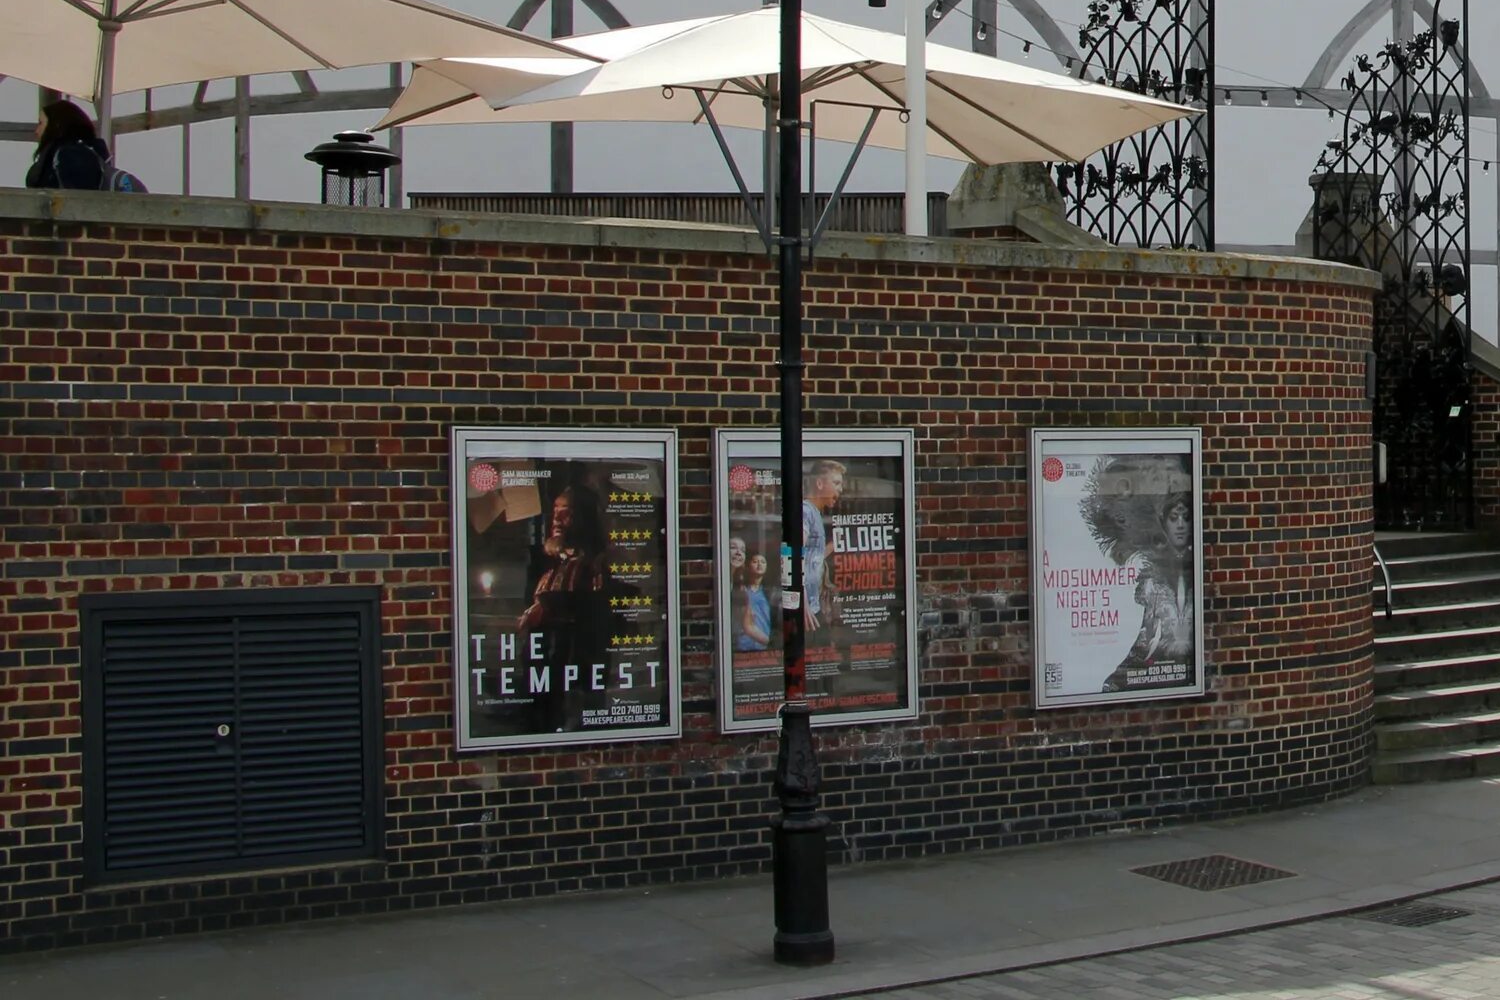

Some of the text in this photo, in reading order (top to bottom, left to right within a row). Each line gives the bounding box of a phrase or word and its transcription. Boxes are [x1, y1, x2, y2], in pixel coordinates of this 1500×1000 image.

[502, 478, 535, 486] PLAYHOUSE
[516, 470, 551, 478] WANAMAKER
[832, 513, 894, 527] SHAKESPEARE'S
[832, 525, 896, 553] GLOBE
[834, 552, 896, 572] SUMMER
[1043, 550, 1049, 567] A
[834, 570, 896, 592] SCHOOLS
[1043, 567, 1136, 588] MIDSUMMER
[866, 594, 881, 602] year
[1056, 588, 1110, 608] NIGHT'S
[1071, 609, 1119, 629] DREAM
[471, 632, 545, 662] THE
[472, 661, 661, 696] TEMPEST
[1148, 666, 1160, 675] 020
[1160, 665, 1172, 674] 7401
[1172, 664, 1186, 673] 9919
[582, 709, 595, 717] BOOK
[611, 706, 625, 716] 020
[627, 705, 642, 715] 7401
[643, 704, 660, 714] 9919
[582, 714, 661, 726] SHAKESPEARESGLOBE.COM
